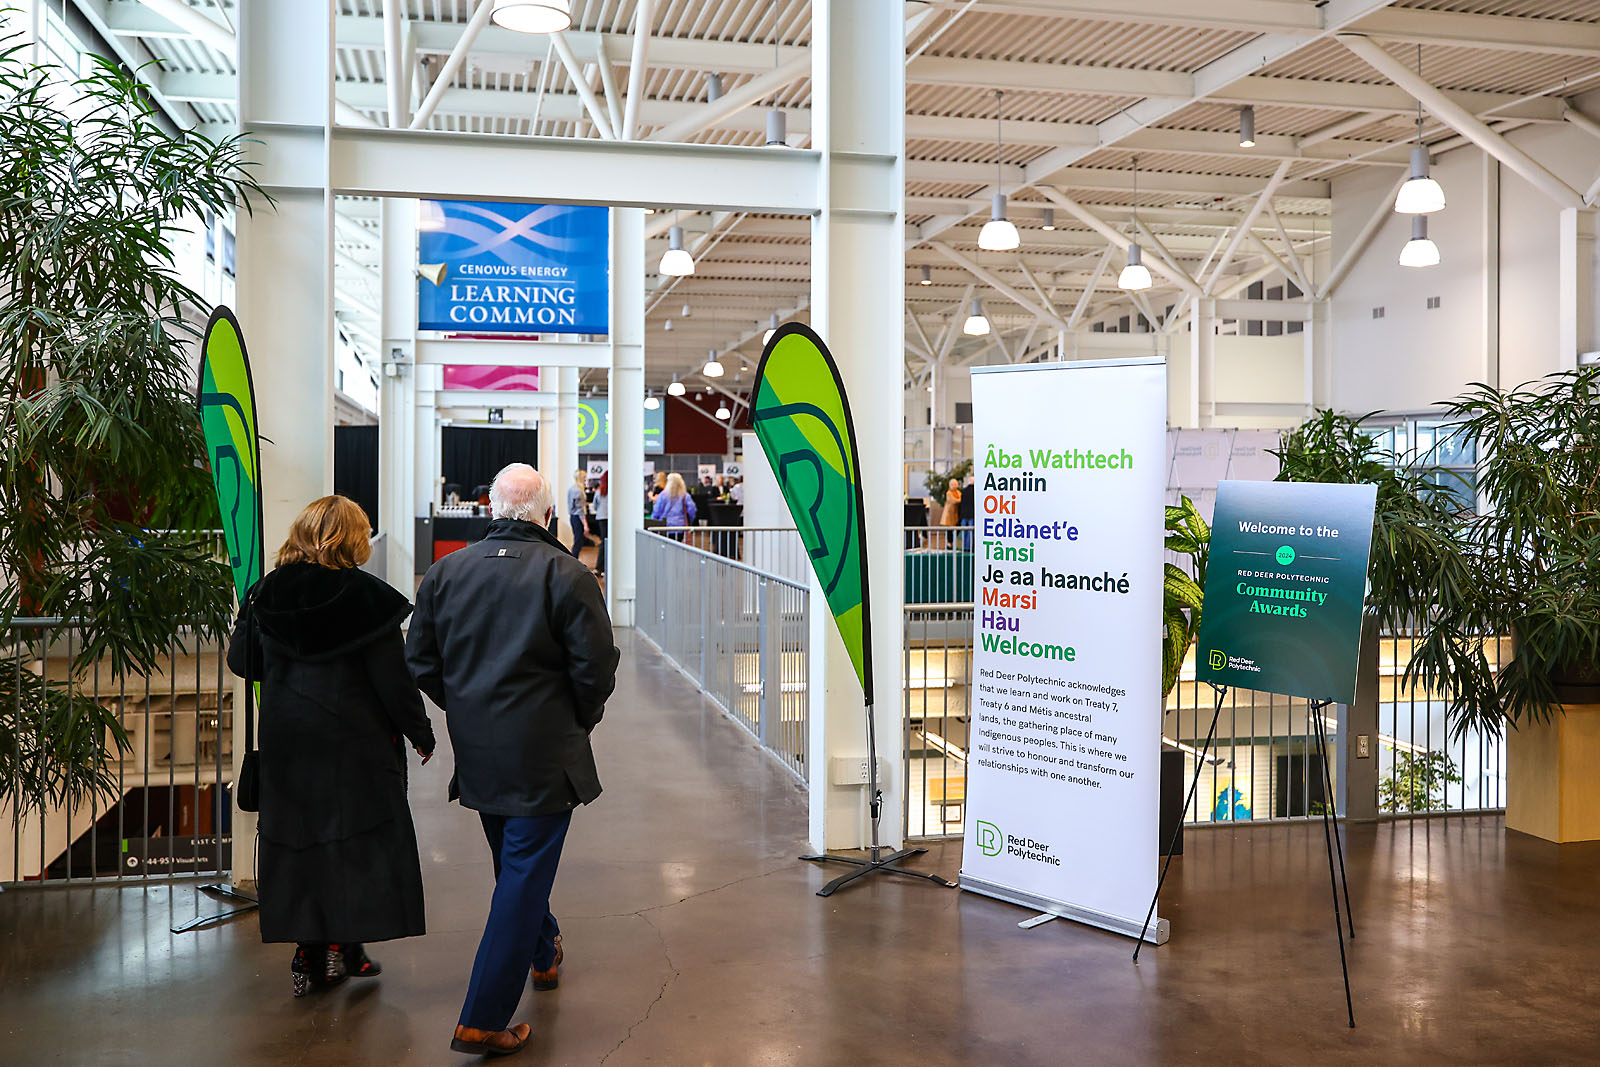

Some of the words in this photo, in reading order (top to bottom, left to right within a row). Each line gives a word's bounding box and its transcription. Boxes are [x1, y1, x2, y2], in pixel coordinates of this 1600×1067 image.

[460, 265, 517, 275] CENOVUS
[520, 266, 568, 277] ENERGY
[451, 285, 575, 304] LEARNING
[450, 306, 575, 324] COMMON
[984, 444, 1022, 468] Âba
[1030, 449, 1132, 469] Wathtech
[984, 472, 1046, 491] Aaniin
[984, 495, 1016, 514] Oki
[1239, 522, 1295, 535] Welcome
[1299, 525, 1313, 536] to
[1316, 526, 1338, 537] the
[983, 541, 1034, 562] Tânsi
[982, 565, 1003, 583] Je
[1010, 571, 1033, 586] aa
[1042, 568, 1129, 593] haanché
[1276, 573, 1329, 583] POLYTECHNIC
[983, 588, 1037, 609] Marsi
[1237, 583, 1328, 605] Community
[1249, 600, 1307, 617] Awards
[982, 610, 1019, 631] Hàu
[981, 633, 1075, 661] Welcome
[1229, 663, 1260, 672] Polytechnic
[980, 669, 993, 678] Red
[996, 672, 1015, 681] Deer
[1018, 674, 1065, 687] Polytechnic
[1068, 681, 1125, 697] acknowledges
[980, 685, 994, 693] that
[1010, 688, 1030, 697] learn
[1033, 691, 1048, 699] and
[1051, 694, 1070, 703] work
[1085, 698, 1110, 711] Treaty
[1112, 703, 1119, 712] 7,
[980, 698, 1002, 710] Treaty
[1012, 703, 1027, 712] and
[1030, 706, 1052, 716] Métis
[1054, 710, 1091, 722] ancestral
[979, 714, 1000, 725] lands,
[1003, 718, 1016, 726] the
[1019, 720, 1058, 735] gathering
[1061, 727, 1082, 738] place
[1084, 730, 1093, 739] of
[1095, 734, 1117, 745] many
[979, 729, 1021, 742] Indigenous
[1024, 736, 1058, 748] peoples.
[1060, 741, 1076, 751] This
[1079, 745, 1085, 753] is
[1088, 747, 1112, 758] where
[992, 747, 1014, 756] strive
[1028, 752, 1056, 764] honour
[1059, 756, 1074, 766] and
[1077, 761, 1116, 776] transform
[1119, 770, 1134, 778] our
[978, 759, 1028, 774] relationships
[1031, 768, 1048, 777] with
[1050, 773, 1065, 781] one
[1068, 774, 1102, 789] another.
[1008, 835, 1025, 846] Red
[1028, 840, 1049, 852] Deer
[1008, 846, 1060, 866] Polytechnic
